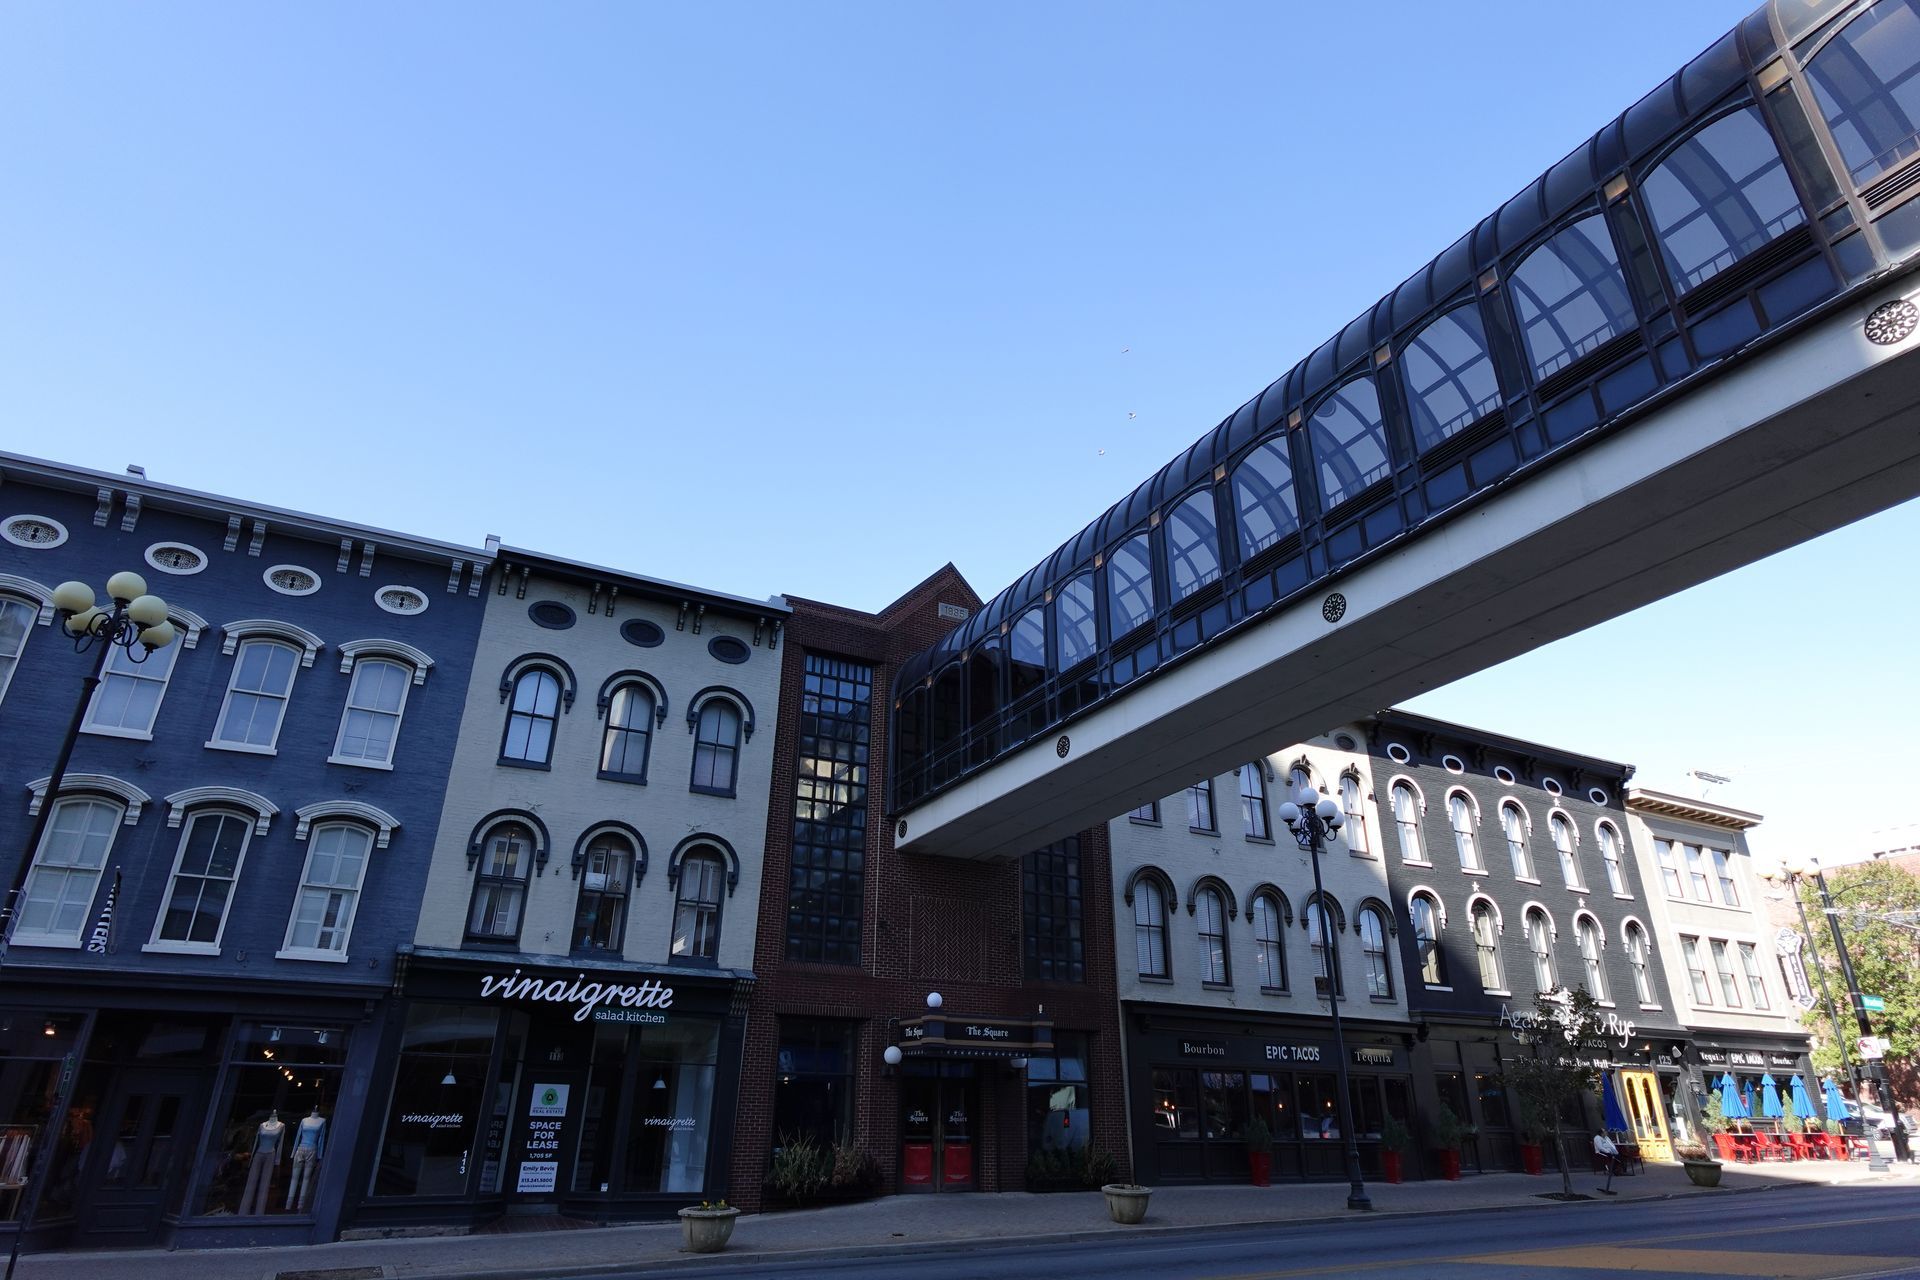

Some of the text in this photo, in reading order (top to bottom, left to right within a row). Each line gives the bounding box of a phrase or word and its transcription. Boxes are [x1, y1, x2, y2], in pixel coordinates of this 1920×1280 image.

[480, 968, 674, 1022] vinaigrette
[595, 1011, 665, 1023] salad kitchen
[905, 1026, 923, 1040] The Squ
[965, 1025, 1009, 1041] The Square
[1608, 1012, 1636, 1049] Rye
[1184, 1042, 1225, 1055] Bourbon
[1585, 1039, 1607, 1049] ACOS
[1266, 1045, 1320, 1061] EPIC TACOS
[1354, 1051, 1391, 1065] Tequila
[1730, 1053, 1764, 1065] EPIC TACOS
[1658, 1055, 1672, 1065] 123
[402, 1112, 463, 1129] vinaigrette
[530, 1121, 562, 1130] SPACE
[645, 1116, 696, 1131] vinaigrette
[533, 1131, 555, 1140] FOR
[526, 1141, 559, 1149] LEASE
